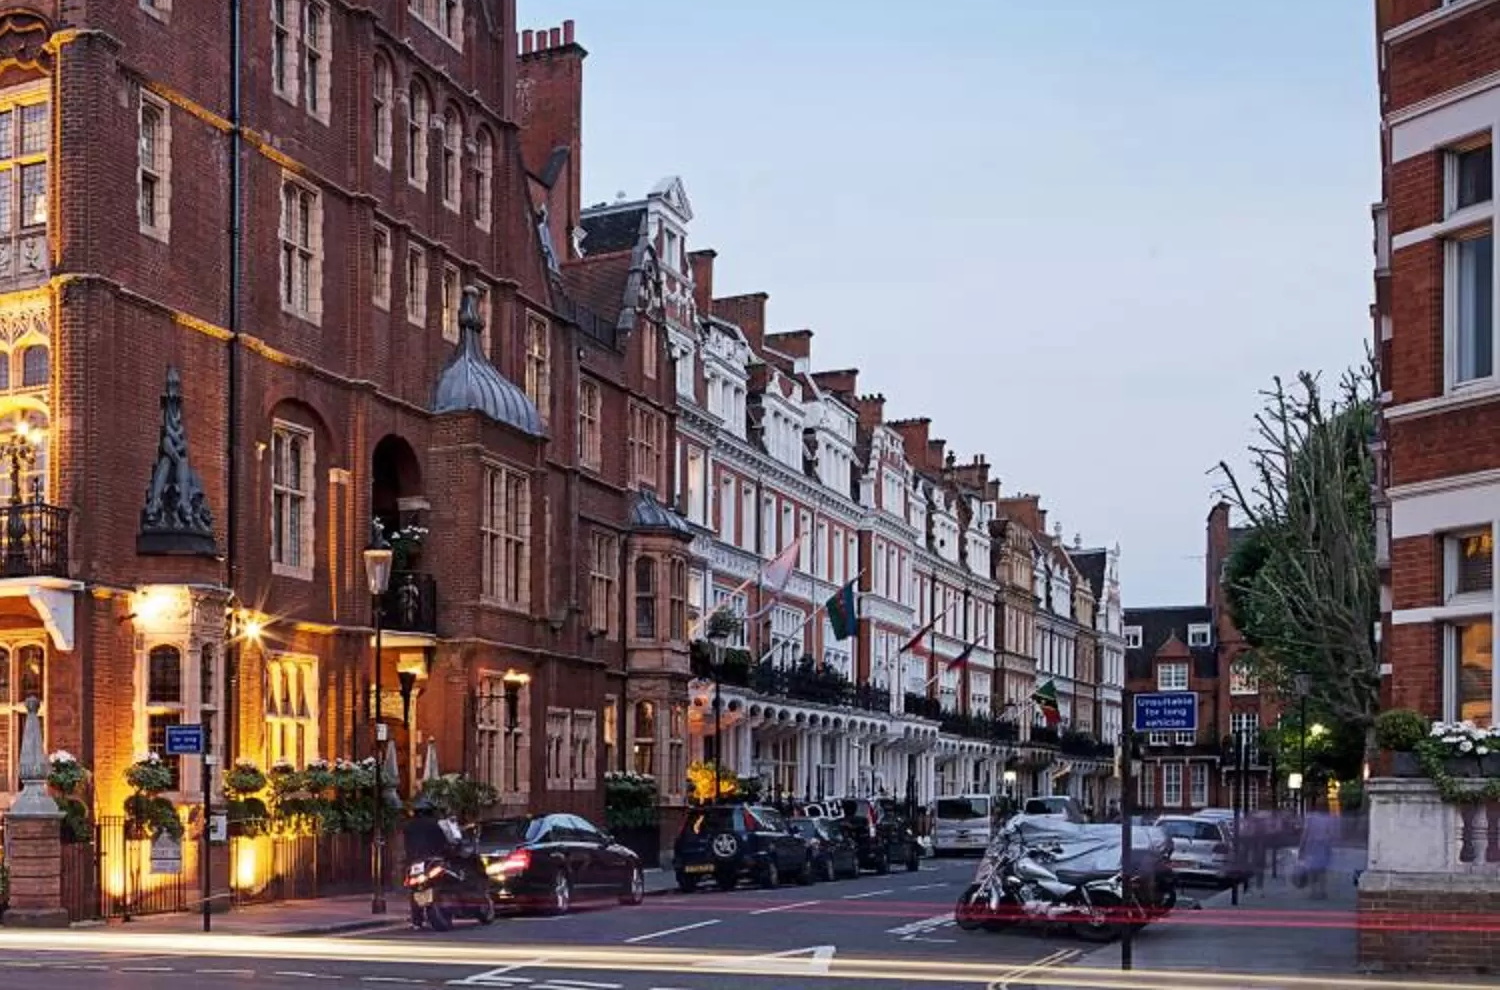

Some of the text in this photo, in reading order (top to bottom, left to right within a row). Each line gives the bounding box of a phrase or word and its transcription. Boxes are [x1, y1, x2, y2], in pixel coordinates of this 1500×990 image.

[1137, 697, 1193, 707] Unsuitable
[1145, 707, 1187, 717] for long
[1145, 718, 1187, 727] vehicles
